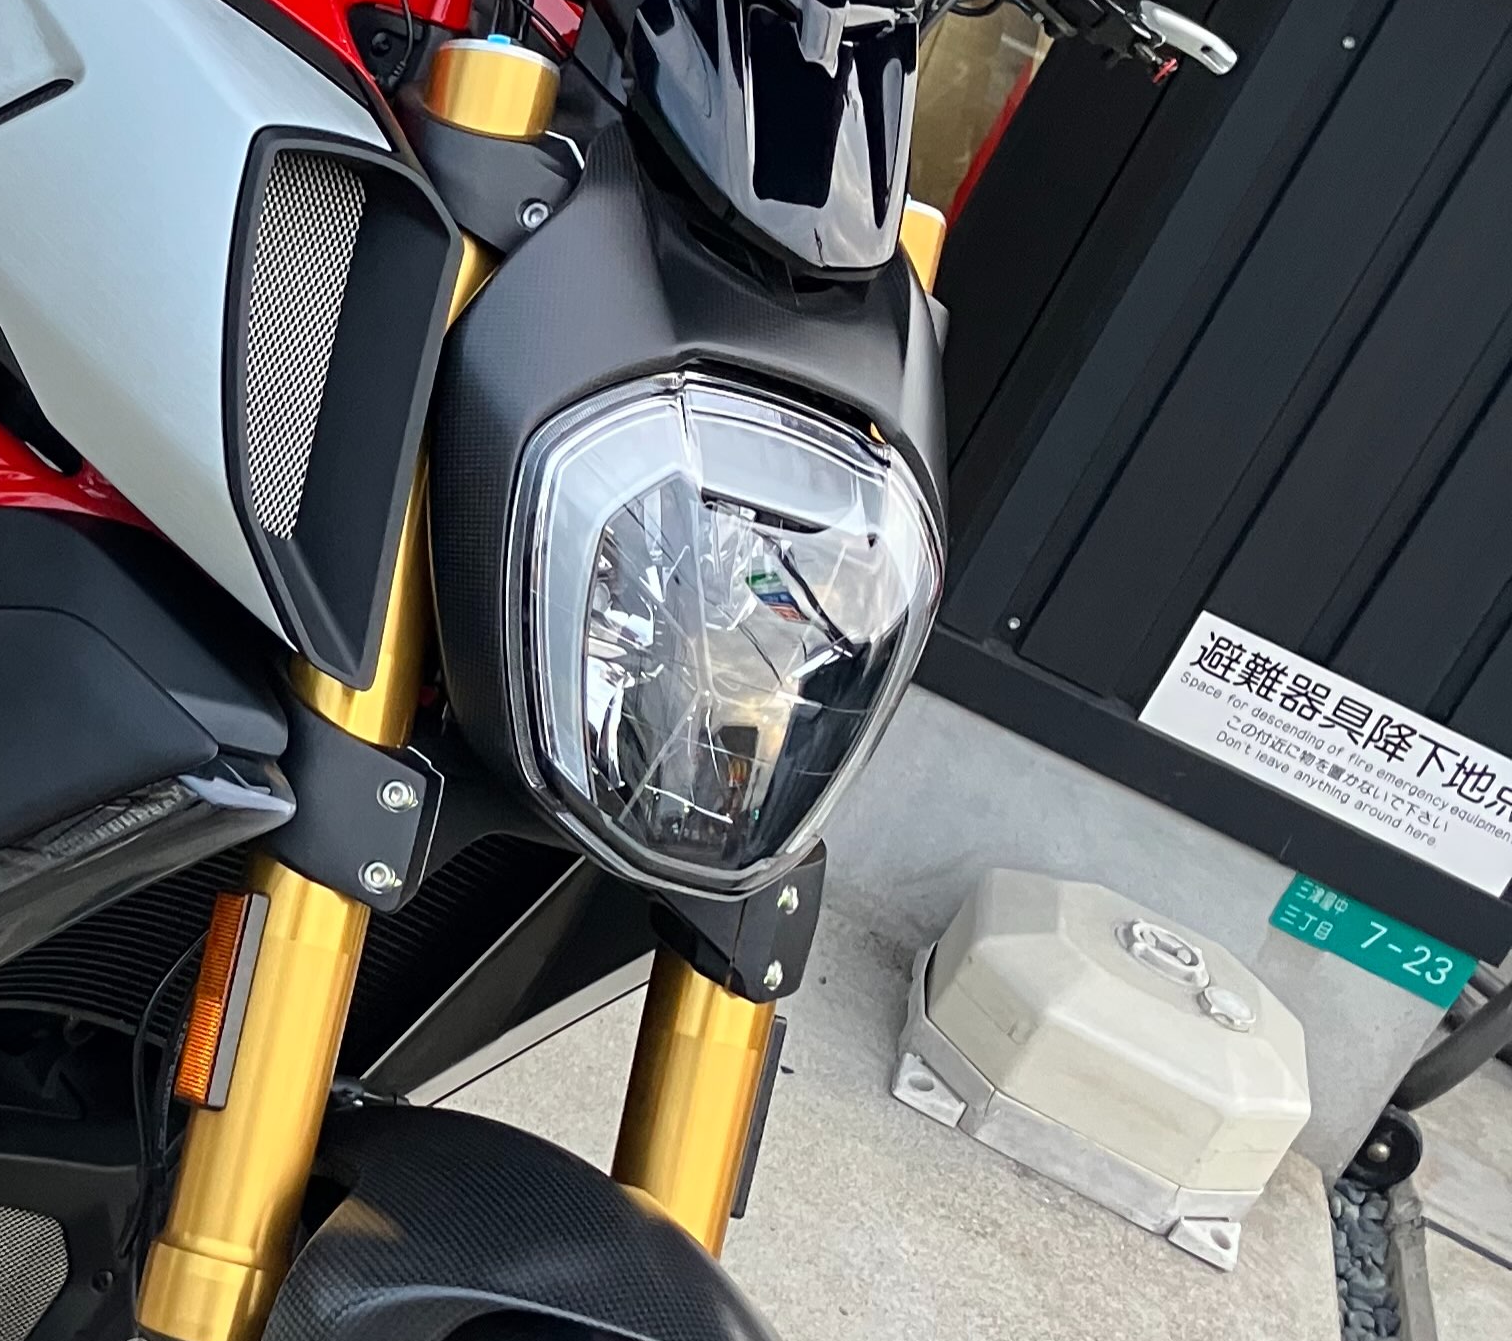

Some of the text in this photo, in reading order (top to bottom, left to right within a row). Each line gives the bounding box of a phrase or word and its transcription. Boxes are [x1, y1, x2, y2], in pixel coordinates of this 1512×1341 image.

[1180, 671, 1512, 844] Space for descending of fire emergency equipmen
[1216, 730, 1252, 755] Don't
[1255, 749, 1290, 774] leave
[1294, 768, 1351, 805] anything
[1354, 799, 1403, 829] around
[1226, 715, 1449, 832] この付近に物を置かないで下さい
[1280, 903, 1334, 941] 三丁目
[1360, 920, 1455, 986] 7-23
